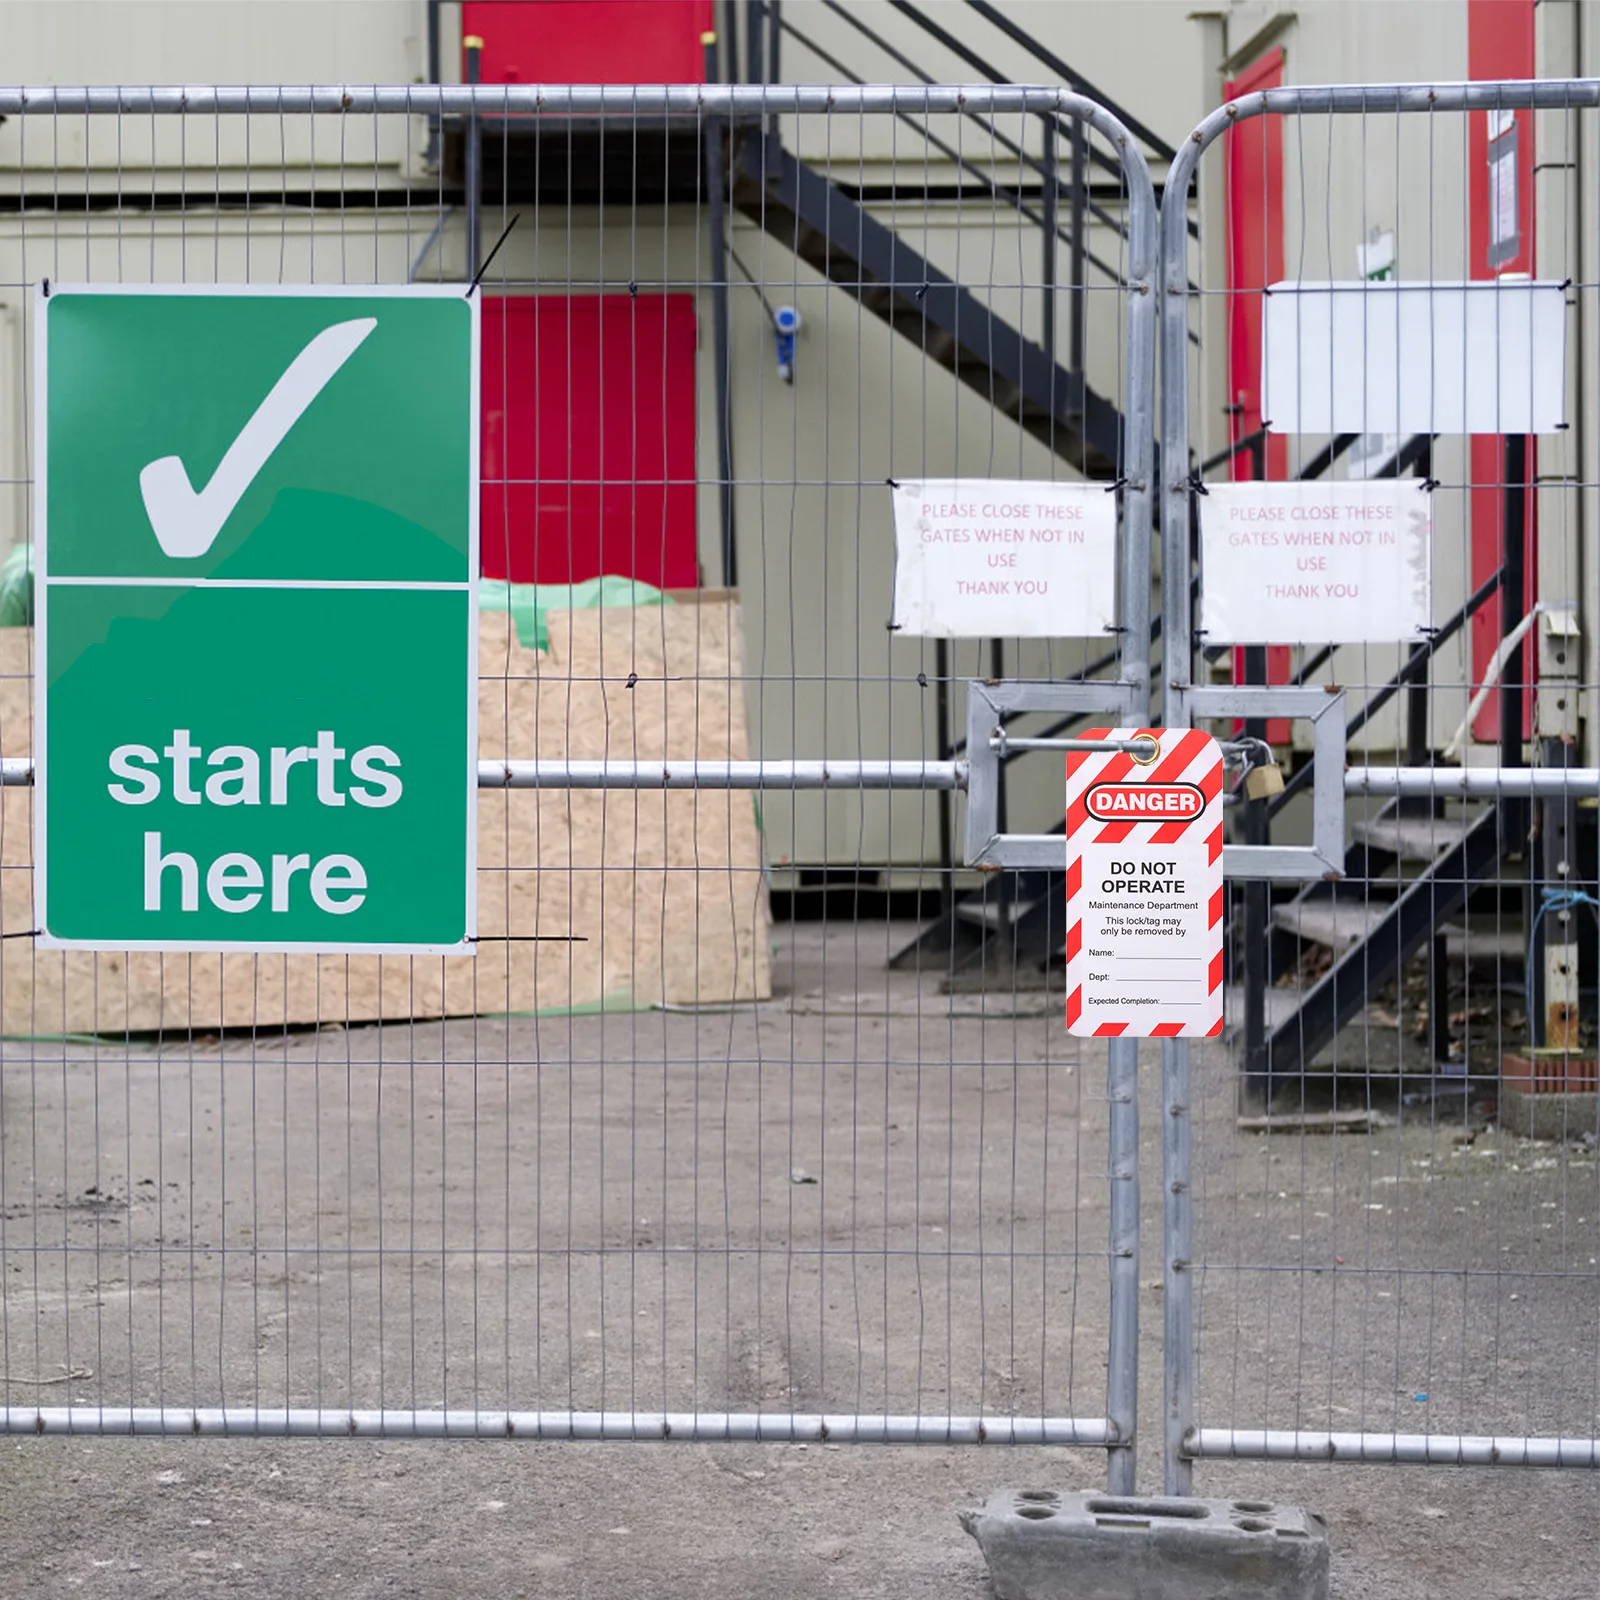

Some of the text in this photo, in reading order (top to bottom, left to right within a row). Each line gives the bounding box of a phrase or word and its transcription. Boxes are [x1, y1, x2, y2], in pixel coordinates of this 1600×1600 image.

[923, 504, 1083, 519] PLEASE CLOSE THESE
[1231, 506, 1393, 521] PLEASE CLOSE THESE
[921, 529, 1085, 544] GATES WHEN NOT IN
[1229, 530, 1396, 546] GATES WHEN NOT IN
[988, 553, 1018, 568] USE
[1297, 555, 1327, 572] USE
[958, 581, 1048, 595] THANK YOU
[1267, 584, 1358, 599] THANK YOU
[108, 729, 403, 807] starts
[1095, 792, 1196, 812] DANGER
[144, 831, 367, 914] here
[1110, 862, 1176, 875] DO NOT
[1101, 880, 1185, 893] OPERATE
[1089, 901, 1198, 911] Maintenance Department
[1105, 917, 1181, 928] This lock/tag may
[1101, 927, 1186, 937] only be removed by
[1089, 973, 1109, 981] Dept:
[1121, 998, 1160, 1006] Completion:
